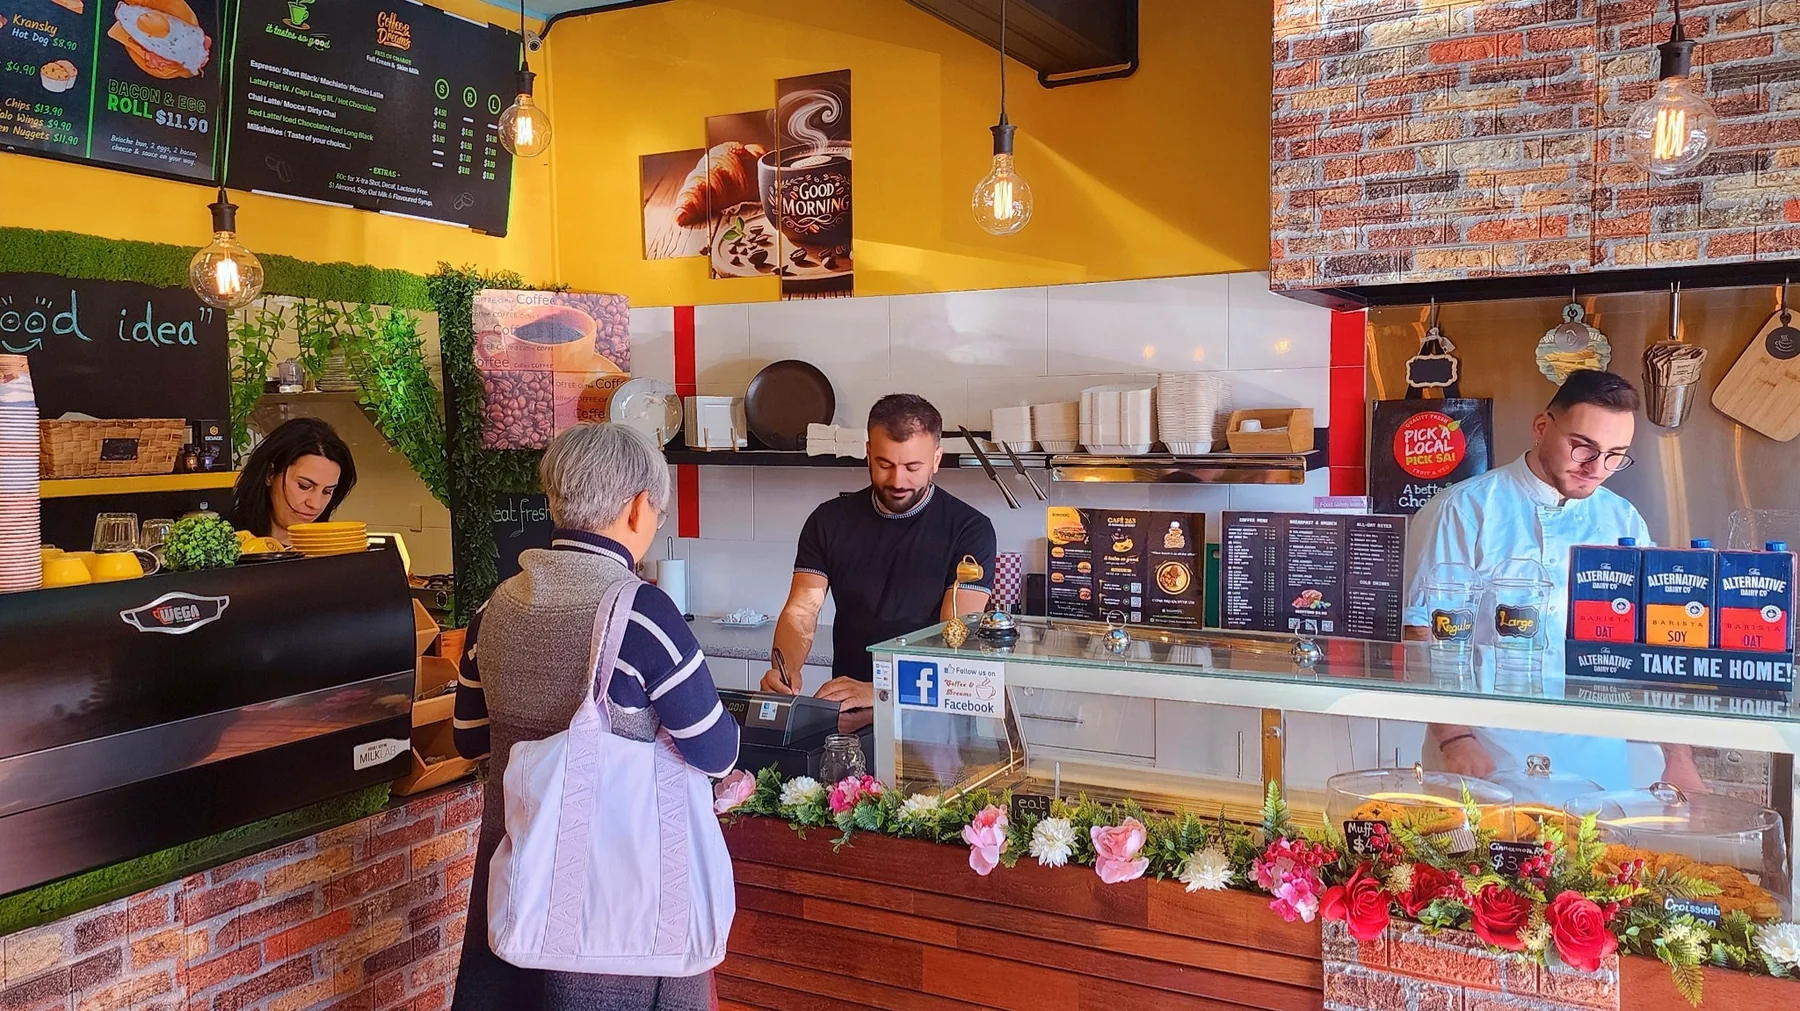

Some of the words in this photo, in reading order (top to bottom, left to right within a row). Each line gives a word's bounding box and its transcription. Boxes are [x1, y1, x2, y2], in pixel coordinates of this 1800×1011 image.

[13, 14, 58, 37] Kransky
[12, 28, 28, 39] Hot
[32, 32, 49, 46] Dog
[52, 38, 77, 50] $8.90
[266, 24, 274, 33] it
[274, 27, 297, 40] tastes
[298, 34, 308, 42] so
[308, 38, 331, 48] good
[6, 61, 36, 76] $4.90
[250, 60, 282, 73] Espresso/
[282, 68, 300, 78] Short
[300, 72, 320, 83] Black/
[349, 84, 370, 96] Piccolo
[370, 90, 384, 100] Latte
[108, 79, 160, 104] BACON
[164, 92, 174, 106] &
[178, 95, 206, 114] EGG
[250, 76, 269, 87] Latte/
[269, 82, 282, 91] Flat
[294, 88, 310, 98] Cap/
[310, 90, 327, 102] Long
[348, 100, 376, 112] Chocolate
[5, 98, 31, 111] Chips
[34, 104, 62, 116] $13.90
[248, 92, 263, 102] Chai
[264, 96, 284, 106] Latte/
[284, 100, 307, 112] Mocca/
[308, 106, 322, 116] Dirty
[322, 109, 336, 118] Chai
[0, 108, 13, 120] alo
[17, 113, 44, 128] Wings
[47, 119, 72, 131] $9.90
[108, 94, 152, 118] ROLL
[156, 109, 208, 134] $11.90
[248, 108, 262, 117] Iced
[262, 110, 283, 121] Latte/
[282, 114, 297, 124] Iced
[297, 118, 330, 132] Chocolate/
[330, 125, 344, 134] Iced
[344, 128, 358, 138] Long
[358, 132, 374, 141] Black
[12, 125, 50, 140] Nuggets
[53, 133, 78, 146] $11.90
[247, 122, 282, 136] Milkshakes
[288, 130, 305, 140] Taste
[312, 136, 326, 145] your
[110, 134, 134, 145] Brioche
[136, 139, 148, 148] bun,
[156, 144, 172, 154] eggs,
[180, 148, 198, 158] bacon,
[112, 144, 132, 154] cheese
[142, 150, 158, 158] sauce
[168, 154, 182, 162] your
[182, 158, 196, 166] way.
[373, 167, 396, 178] EXTRAS
[397, 184, 416, 194] Lactose
[800, 182, 834, 200] GOOD
[782, 194, 850, 216] MORNING
[516, 294, 555, 305] Coffee
[1405, 414, 1429, 428] QUALITY
[1430, 414, 1448, 424] FRESH
[1404, 426, 1438, 444] PICK
[1440, 426, 1451, 440] A
[1404, 440, 1454, 456] LOCAL
[1406, 455, 1434, 466] PICK
[1436, 452, 1456, 463] SA!
[1412, 467, 1430, 476] FRUIT
[1402, 484, 1412, 494] A
[1414, 484, 1442, 494] bette
[1398, 495, 1431, 508] Choi
[492, 498, 518, 522] eat
[520, 498, 553, 532] fresh
[1576, 570, 1634, 586] ALTERNATIVE
[1592, 582, 1609, 590] DAIRY
[1648, 574, 1710, 590] ALTERNATIVE
[1722, 576, 1786, 594] ALTERNATIVE
[1740, 588, 1758, 596] DAIRY
[160, 604, 200, 621] WEGA
[1500, 610, 1534, 632] Large
[1727, 623, 1780, 632] BARISTA
[1596, 626, 1614, 638] OAT
[1668, 630, 1688, 643] SOY
[1744, 635, 1763, 648] OAT
[1578, 654, 1633, 670] ALTERNATIVE
[1640, 653, 1686, 676] TAKE
[1694, 657, 1722, 678] ME
[1729, 659, 1792, 683] HOME!
[956, 666, 977, 676] Follow
[944, 680, 967, 688] Coffee
[968, 680, 975, 688] &
[944, 698, 994, 714] Facebook
[360, 745, 396, 764] MILKLAB
[1018, 796, 1046, 810] eat
[1489, 842, 1534, 854] Cinnamon
